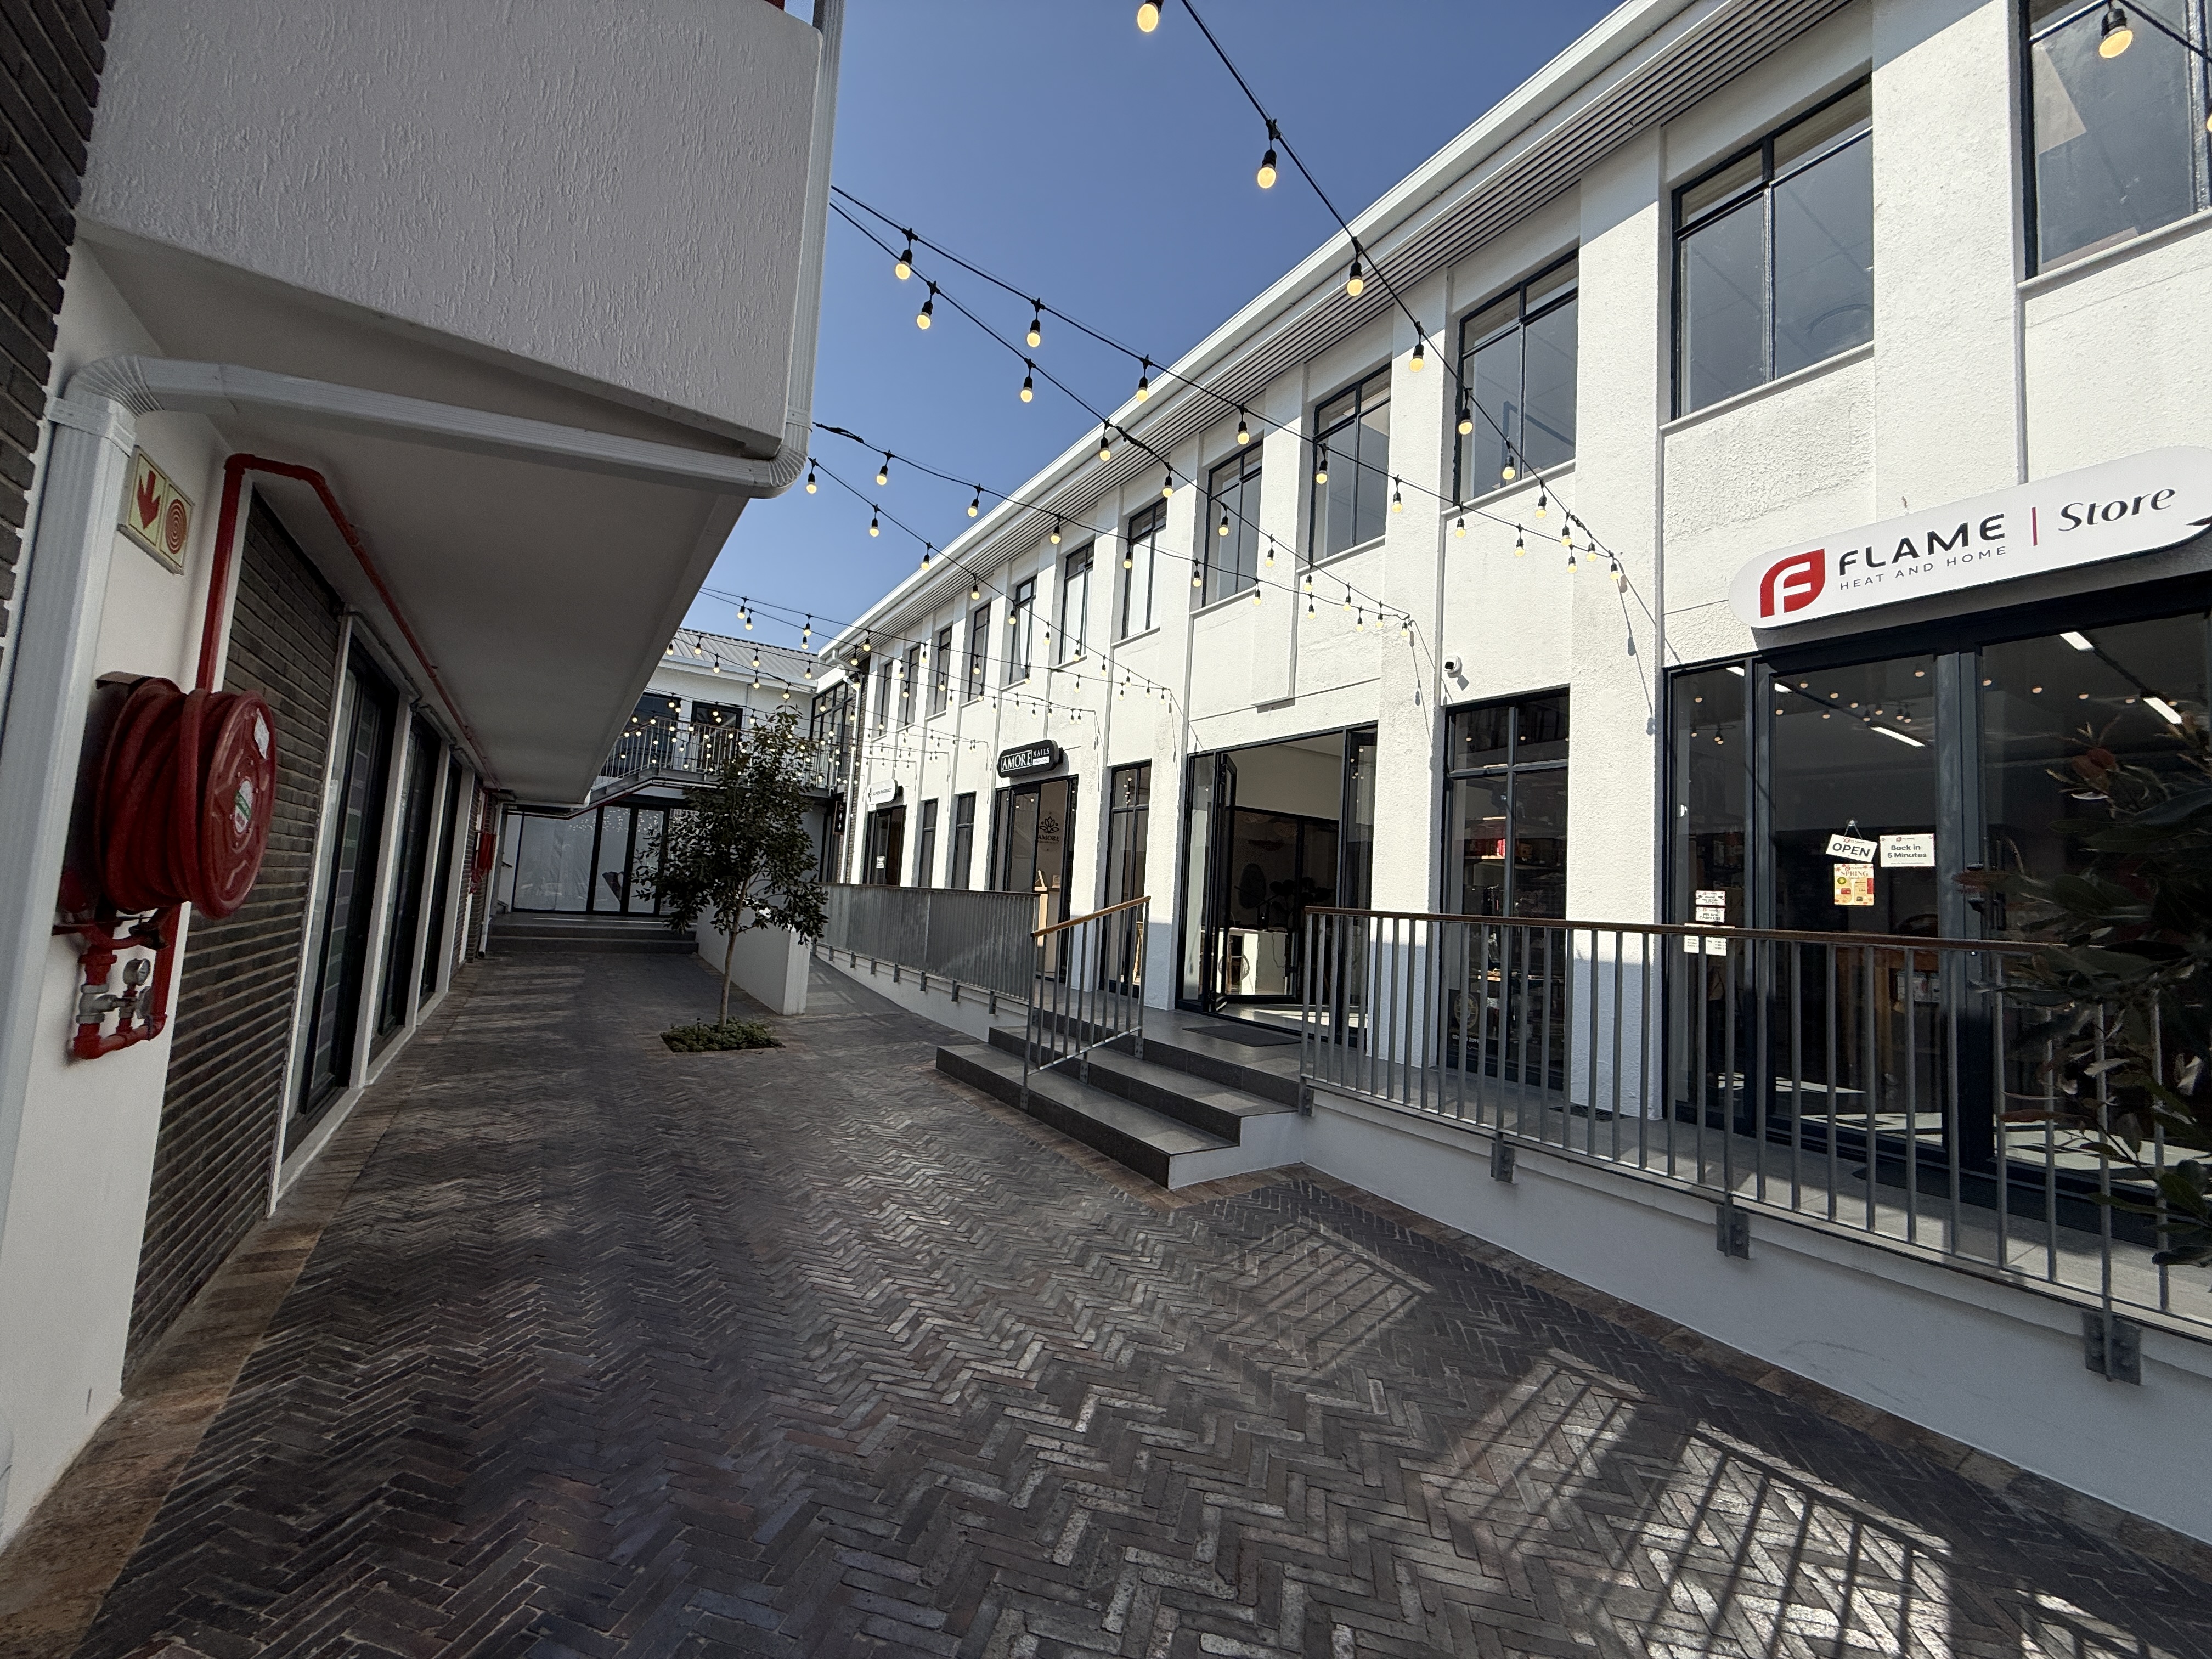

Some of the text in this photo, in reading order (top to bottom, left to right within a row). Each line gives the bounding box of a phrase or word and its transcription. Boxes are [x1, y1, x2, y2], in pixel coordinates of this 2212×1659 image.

[1839, 488, 2176, 576] FLAME Store
[1839, 545, 2006, 591] HEAT AND HOME
[1002, 752, 1031, 770] AMORE
[1032, 747, 1050, 758] NAILS
[1832, 843, 1871, 857] OPEN
